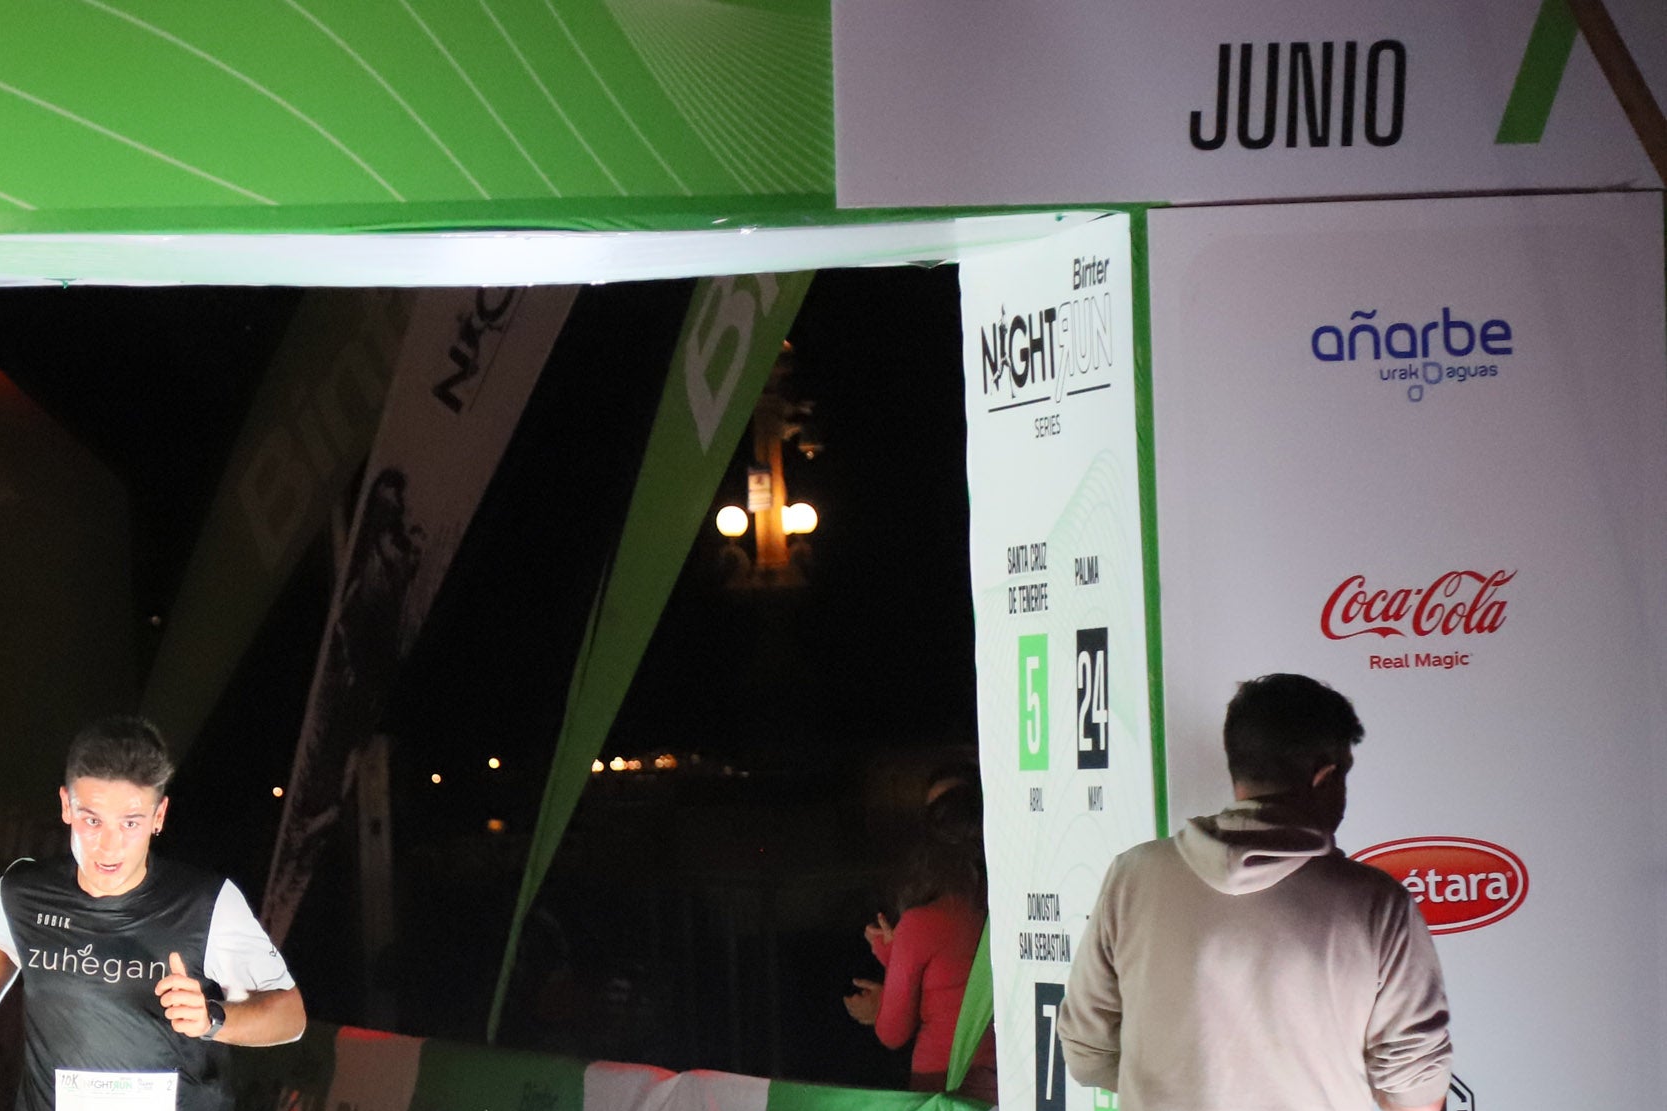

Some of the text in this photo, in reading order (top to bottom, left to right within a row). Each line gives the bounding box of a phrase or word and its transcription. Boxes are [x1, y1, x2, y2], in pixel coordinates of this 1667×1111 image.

[1190, 40, 1407, 150] JUNIO
[1073, 256, 1110, 290] Binter
[1312, 308, 1513, 361] añarbe
[1380, 364, 1498, 383] urak aguas
[1034, 414, 1061, 438] SERIES
[1007, 542, 1047, 575] SANTA CRUZ
[1075, 555, 1099, 586] PALMA
[1009, 583, 1048, 614] DE TENERIFE
[1321, 569, 1518, 639] Coca-Cola
[1369, 651, 1470, 672] Real Magic
[1026, 656, 1041, 754] 5
[1077, 650, 1108, 751] 24
[1401, 868, 1509, 903] étara
[1027, 893, 1061, 921] DONOSTIA
[1019, 929, 1070, 962] SAN SEBASTIÁN
[28, 944, 166, 983] zuhegan
[1043, 1004, 1056, 1100] 7
